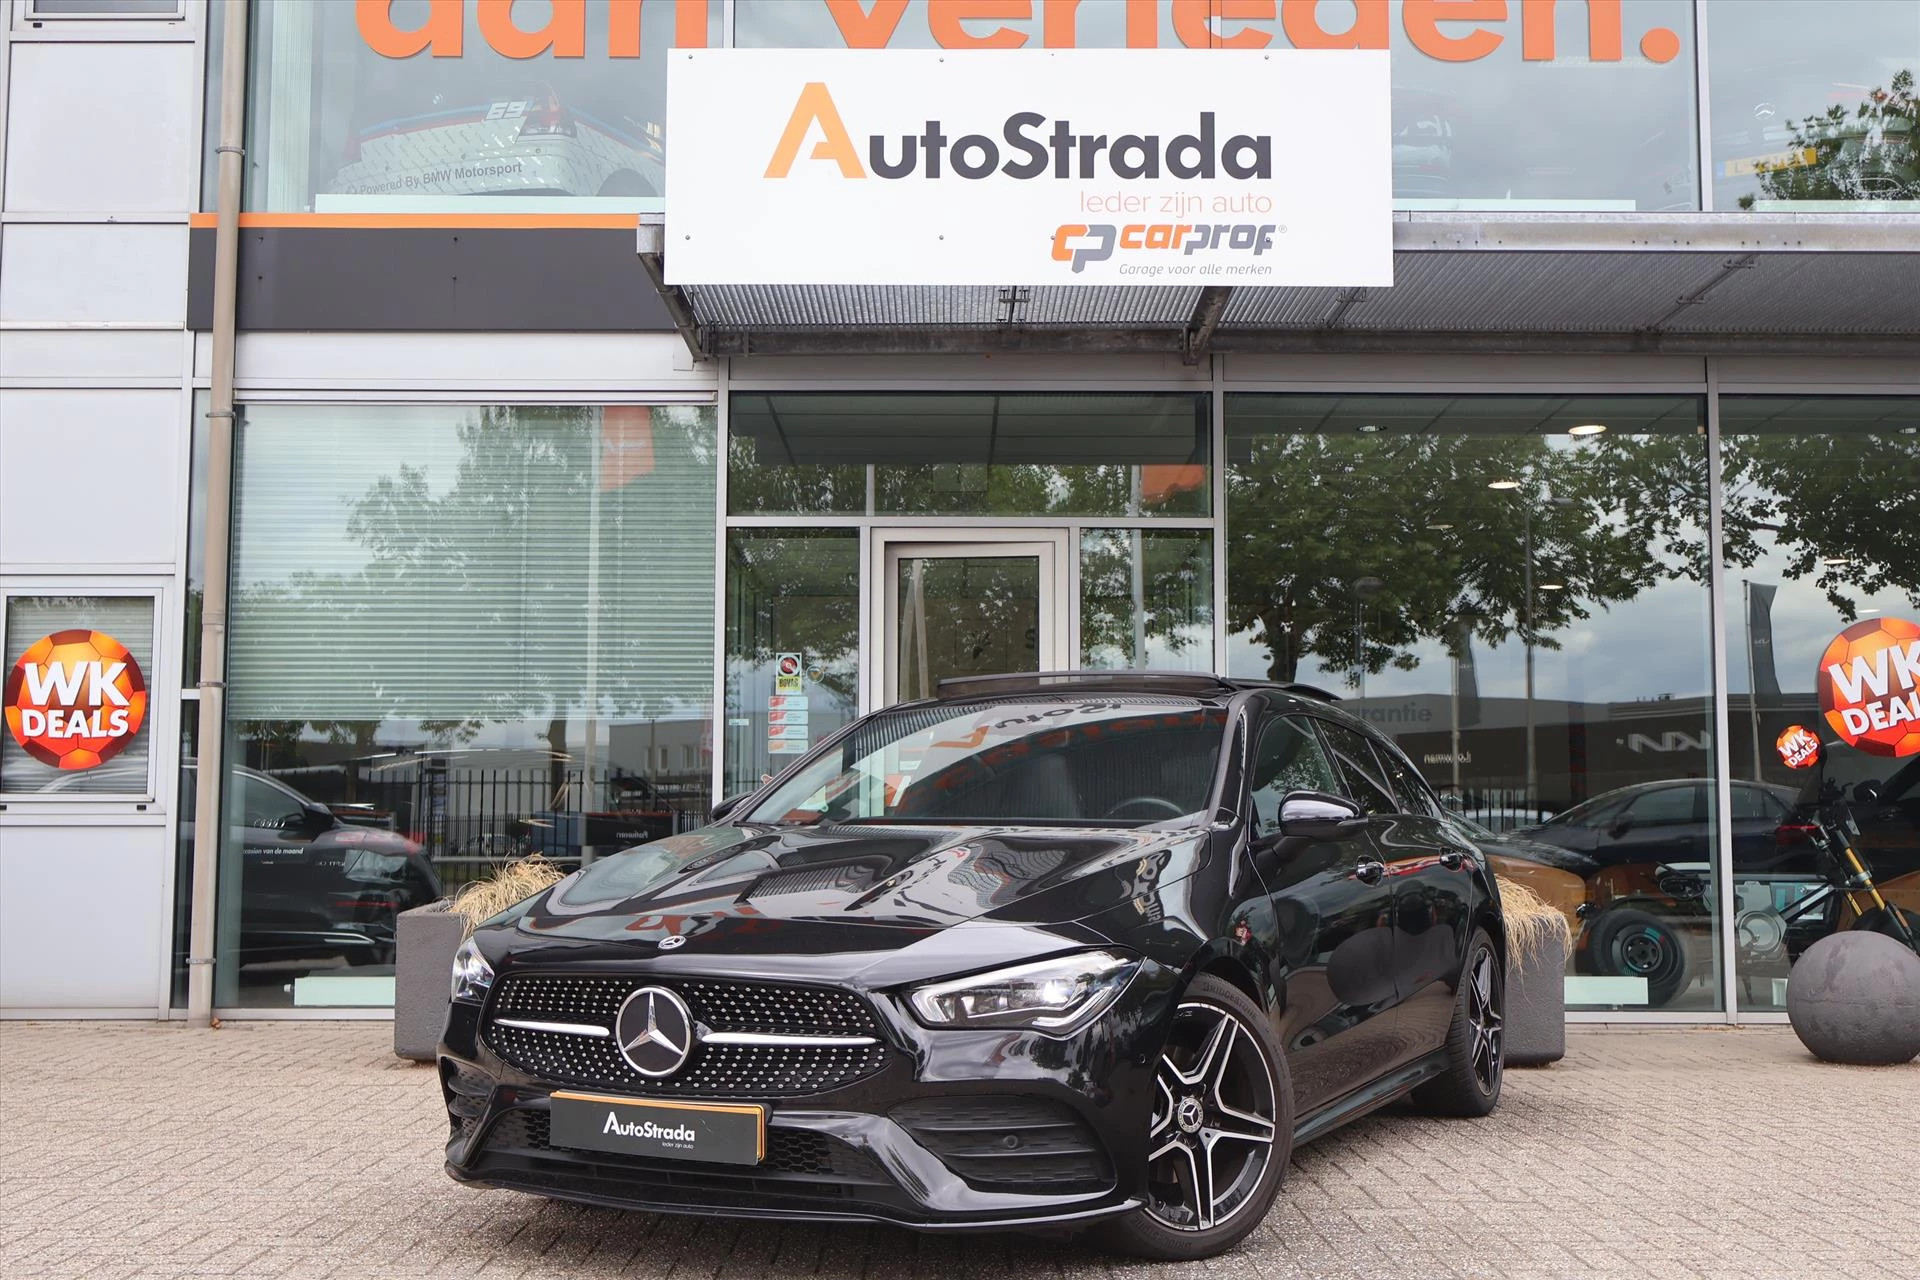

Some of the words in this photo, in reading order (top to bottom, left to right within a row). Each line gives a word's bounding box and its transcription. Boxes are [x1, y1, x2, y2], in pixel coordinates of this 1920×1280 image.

[763, 82, 1272, 180] AutoStrada
[360, 176, 402, 195] Powered
[405, 174, 420, 189] By
[423, 168, 451, 185] BMW
[455, 161, 522, 181] Motorsport
[1081, 191, 1151, 213] Ieder
[1160, 192, 1203, 218] zijn
[1212, 192, 1272, 213] auto
[1119, 264, 1164, 277] Garage
[1168, 265, 1196, 275] voor
[1199, 263, 1222, 275] alle
[1226, 263, 1272, 275] merken
[24, 661, 130, 706] WK
[1828, 640, 1920, 705] WK
[21, 709, 130, 738] DEALS
[1357, 702, 1433, 722] rantie
[1841, 690, 1920, 736] DEAL
[1778, 728, 1813, 758] WK
[1788, 739, 1819, 767] DEALS
[603, 1111, 695, 1142] AutoStrada
